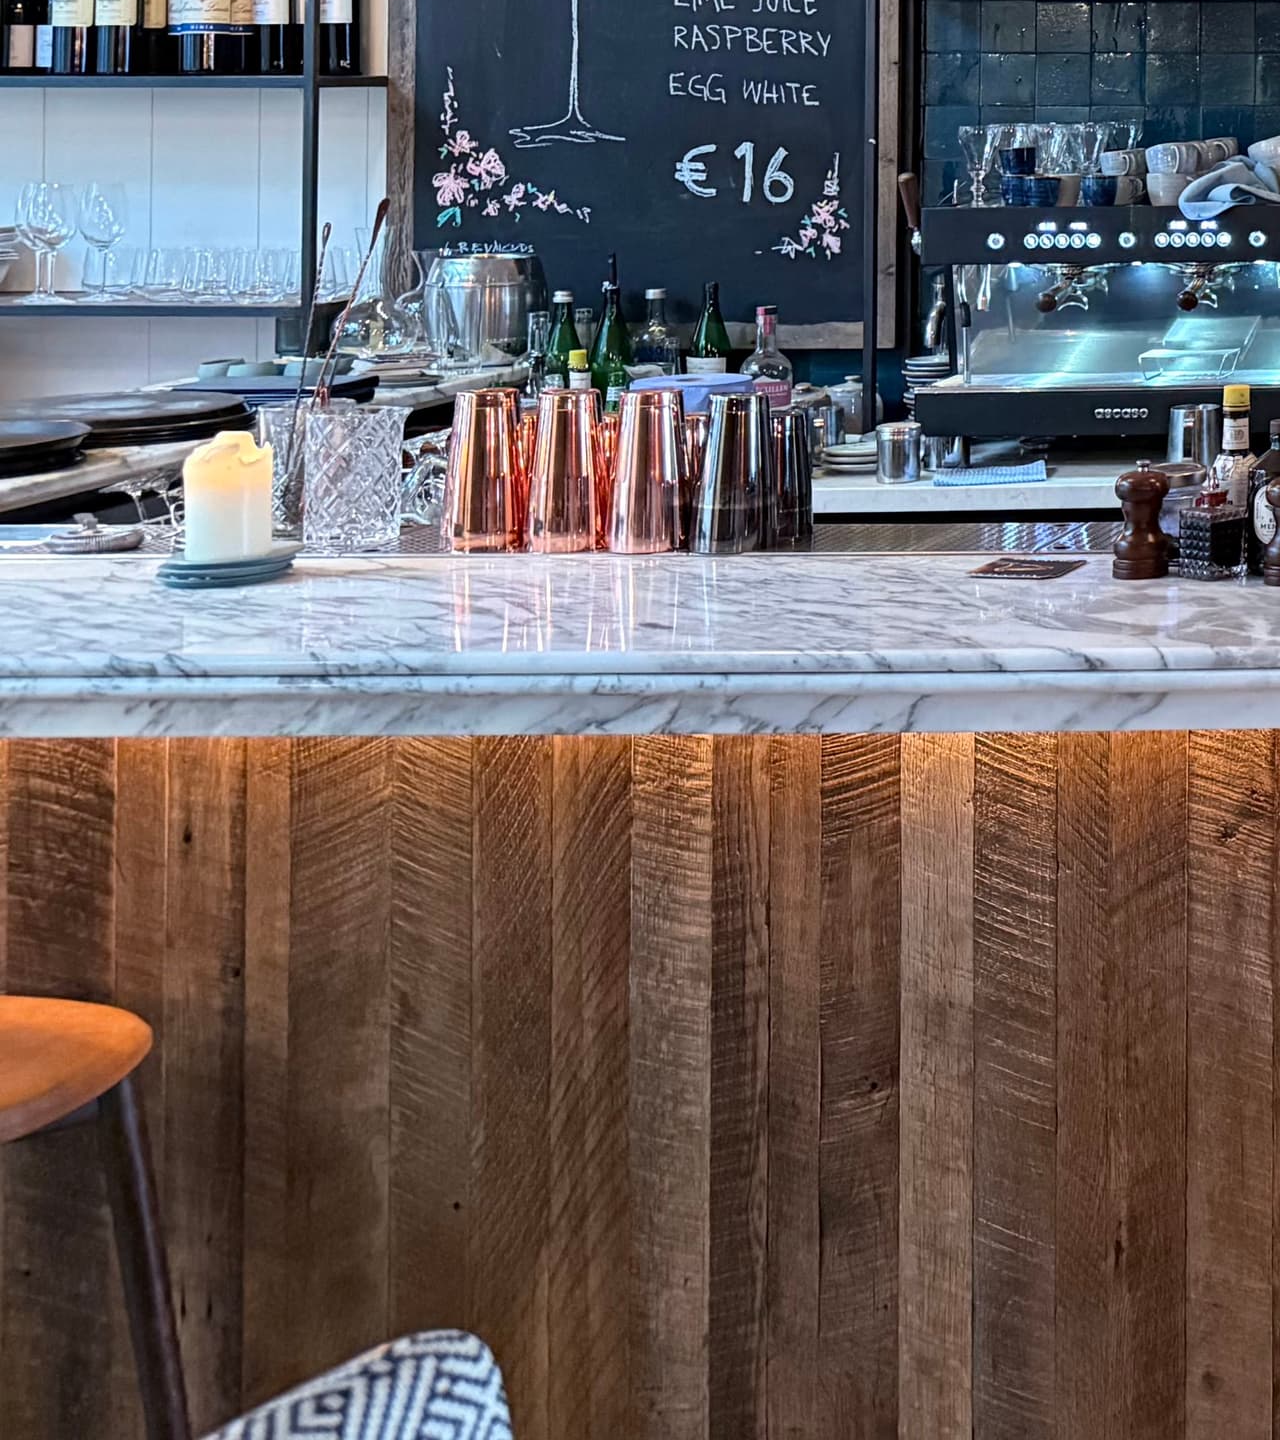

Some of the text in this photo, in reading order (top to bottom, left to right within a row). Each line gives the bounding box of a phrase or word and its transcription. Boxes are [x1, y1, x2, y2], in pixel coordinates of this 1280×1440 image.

[674, 24, 831, 56] RASPBERRY
[669, 72, 820, 106] EGG WHITE
[674, 140, 795, 205] € 16
[1094, 407, 1149, 419] ascaso
